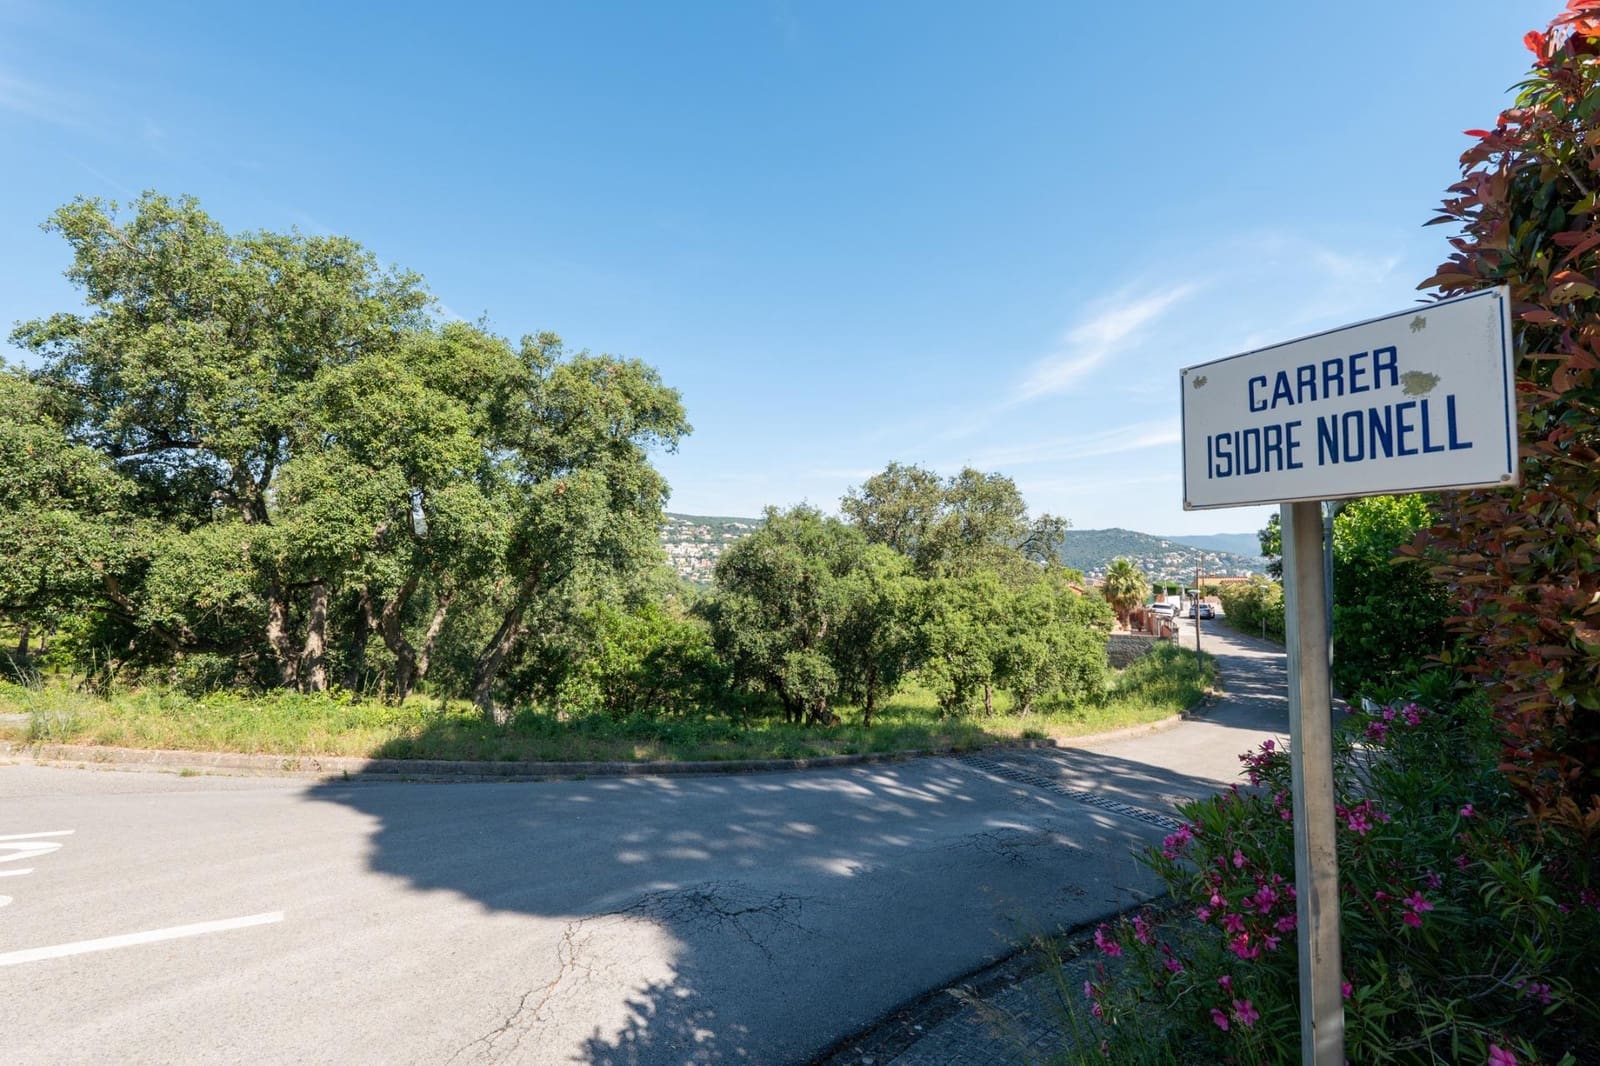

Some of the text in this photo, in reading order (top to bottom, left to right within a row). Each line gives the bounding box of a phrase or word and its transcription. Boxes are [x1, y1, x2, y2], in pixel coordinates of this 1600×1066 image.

[1249, 346, 1399, 412] CARRER
[1207, 394, 1473, 479] ISIDRE NONELL
